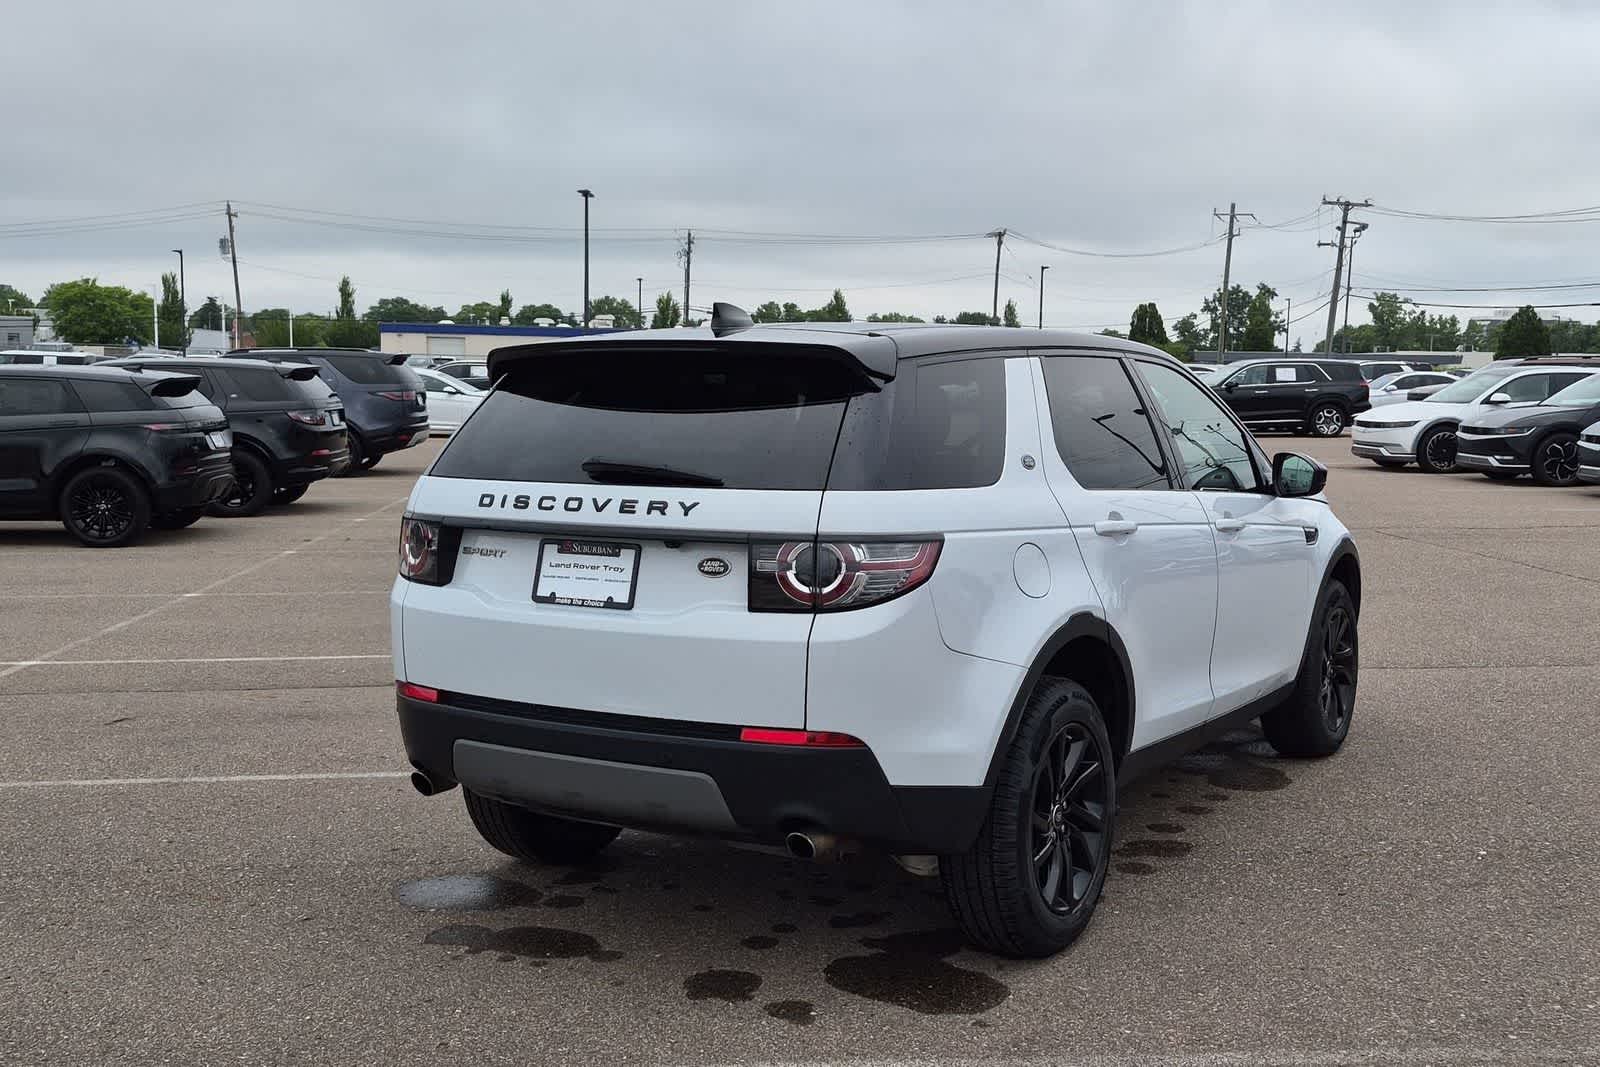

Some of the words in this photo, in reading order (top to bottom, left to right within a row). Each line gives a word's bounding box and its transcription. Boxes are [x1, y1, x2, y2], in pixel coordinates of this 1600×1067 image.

[478, 493, 700, 517] DISCOVERY
[462, 546, 507, 558] SPORT
[573, 563, 600, 571] Rover
[602, 565, 625, 573] Troy
[584, 599, 605, 607] choice
